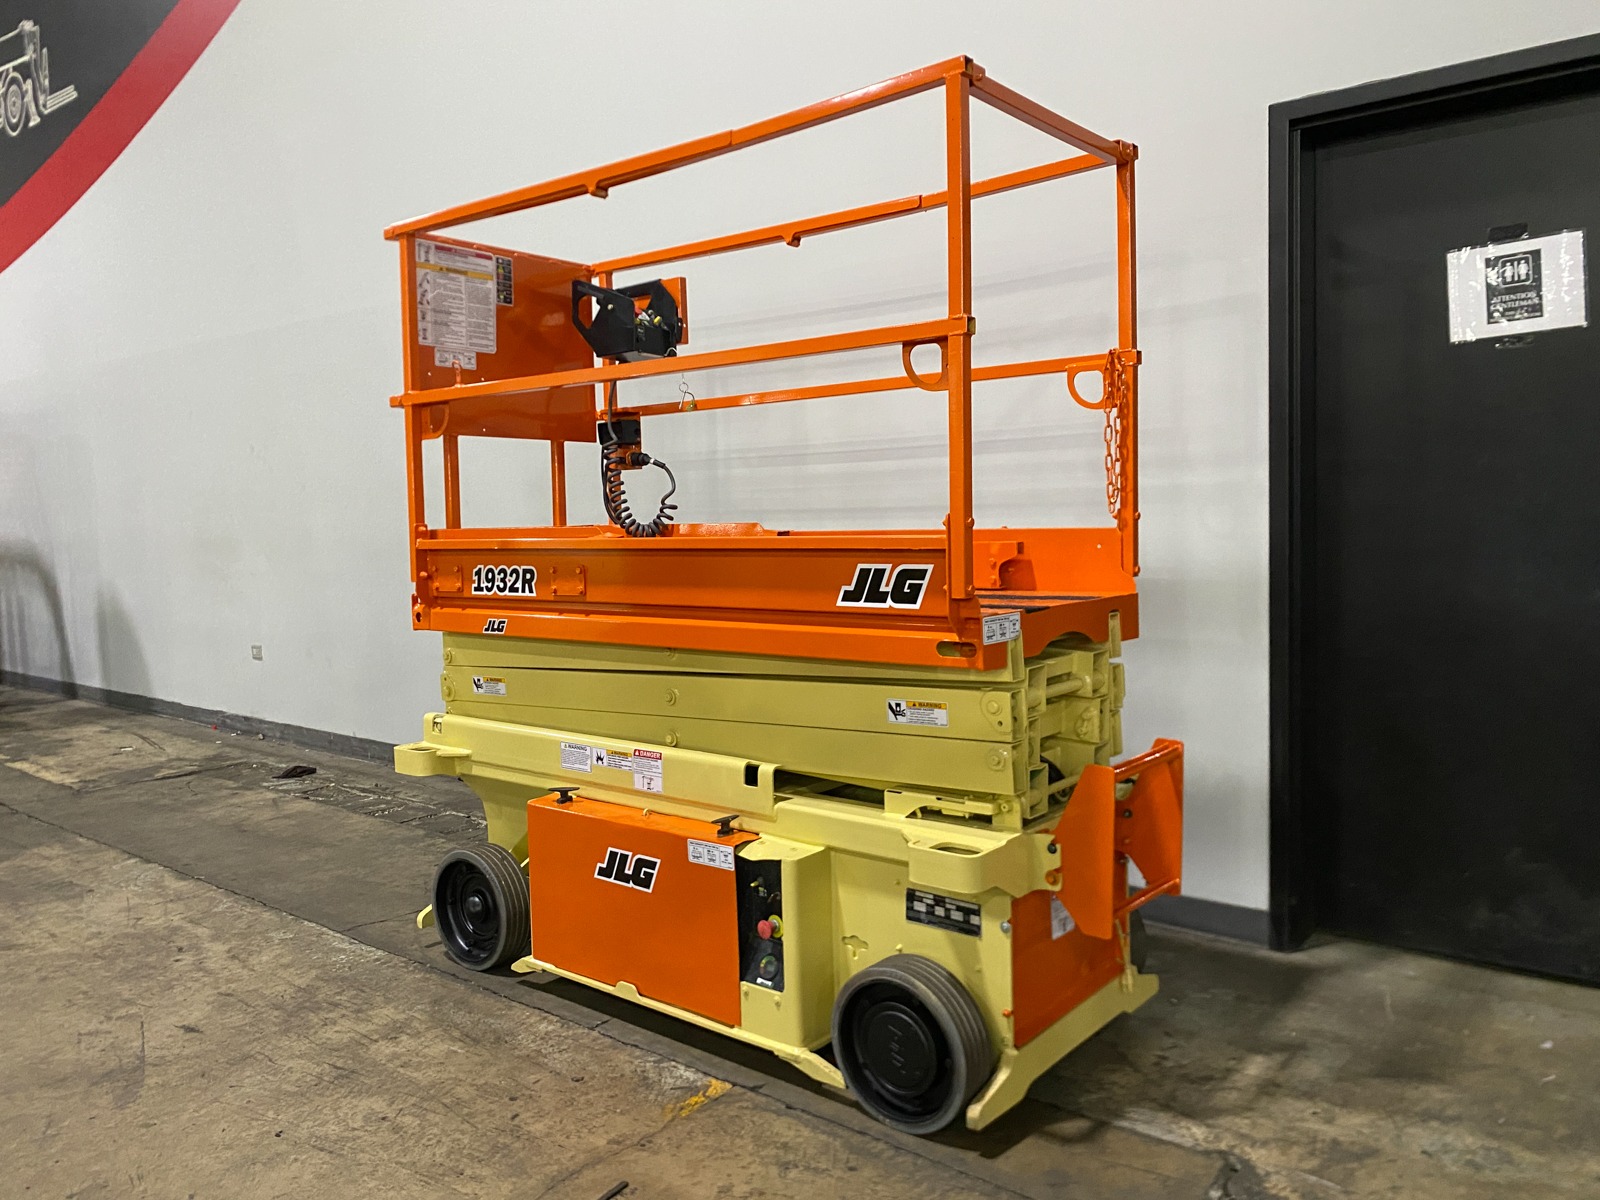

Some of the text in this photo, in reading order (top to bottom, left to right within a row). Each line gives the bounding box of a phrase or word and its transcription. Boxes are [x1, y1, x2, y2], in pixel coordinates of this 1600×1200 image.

[473, 567, 535, 594] 1932R
[840, 567, 929, 605] JLG
[483, 619, 507, 633] JLG
[567, 744, 588, 752] WARNING
[639, 750, 661, 759] DANGER
[596, 850, 658, 891] JLG
